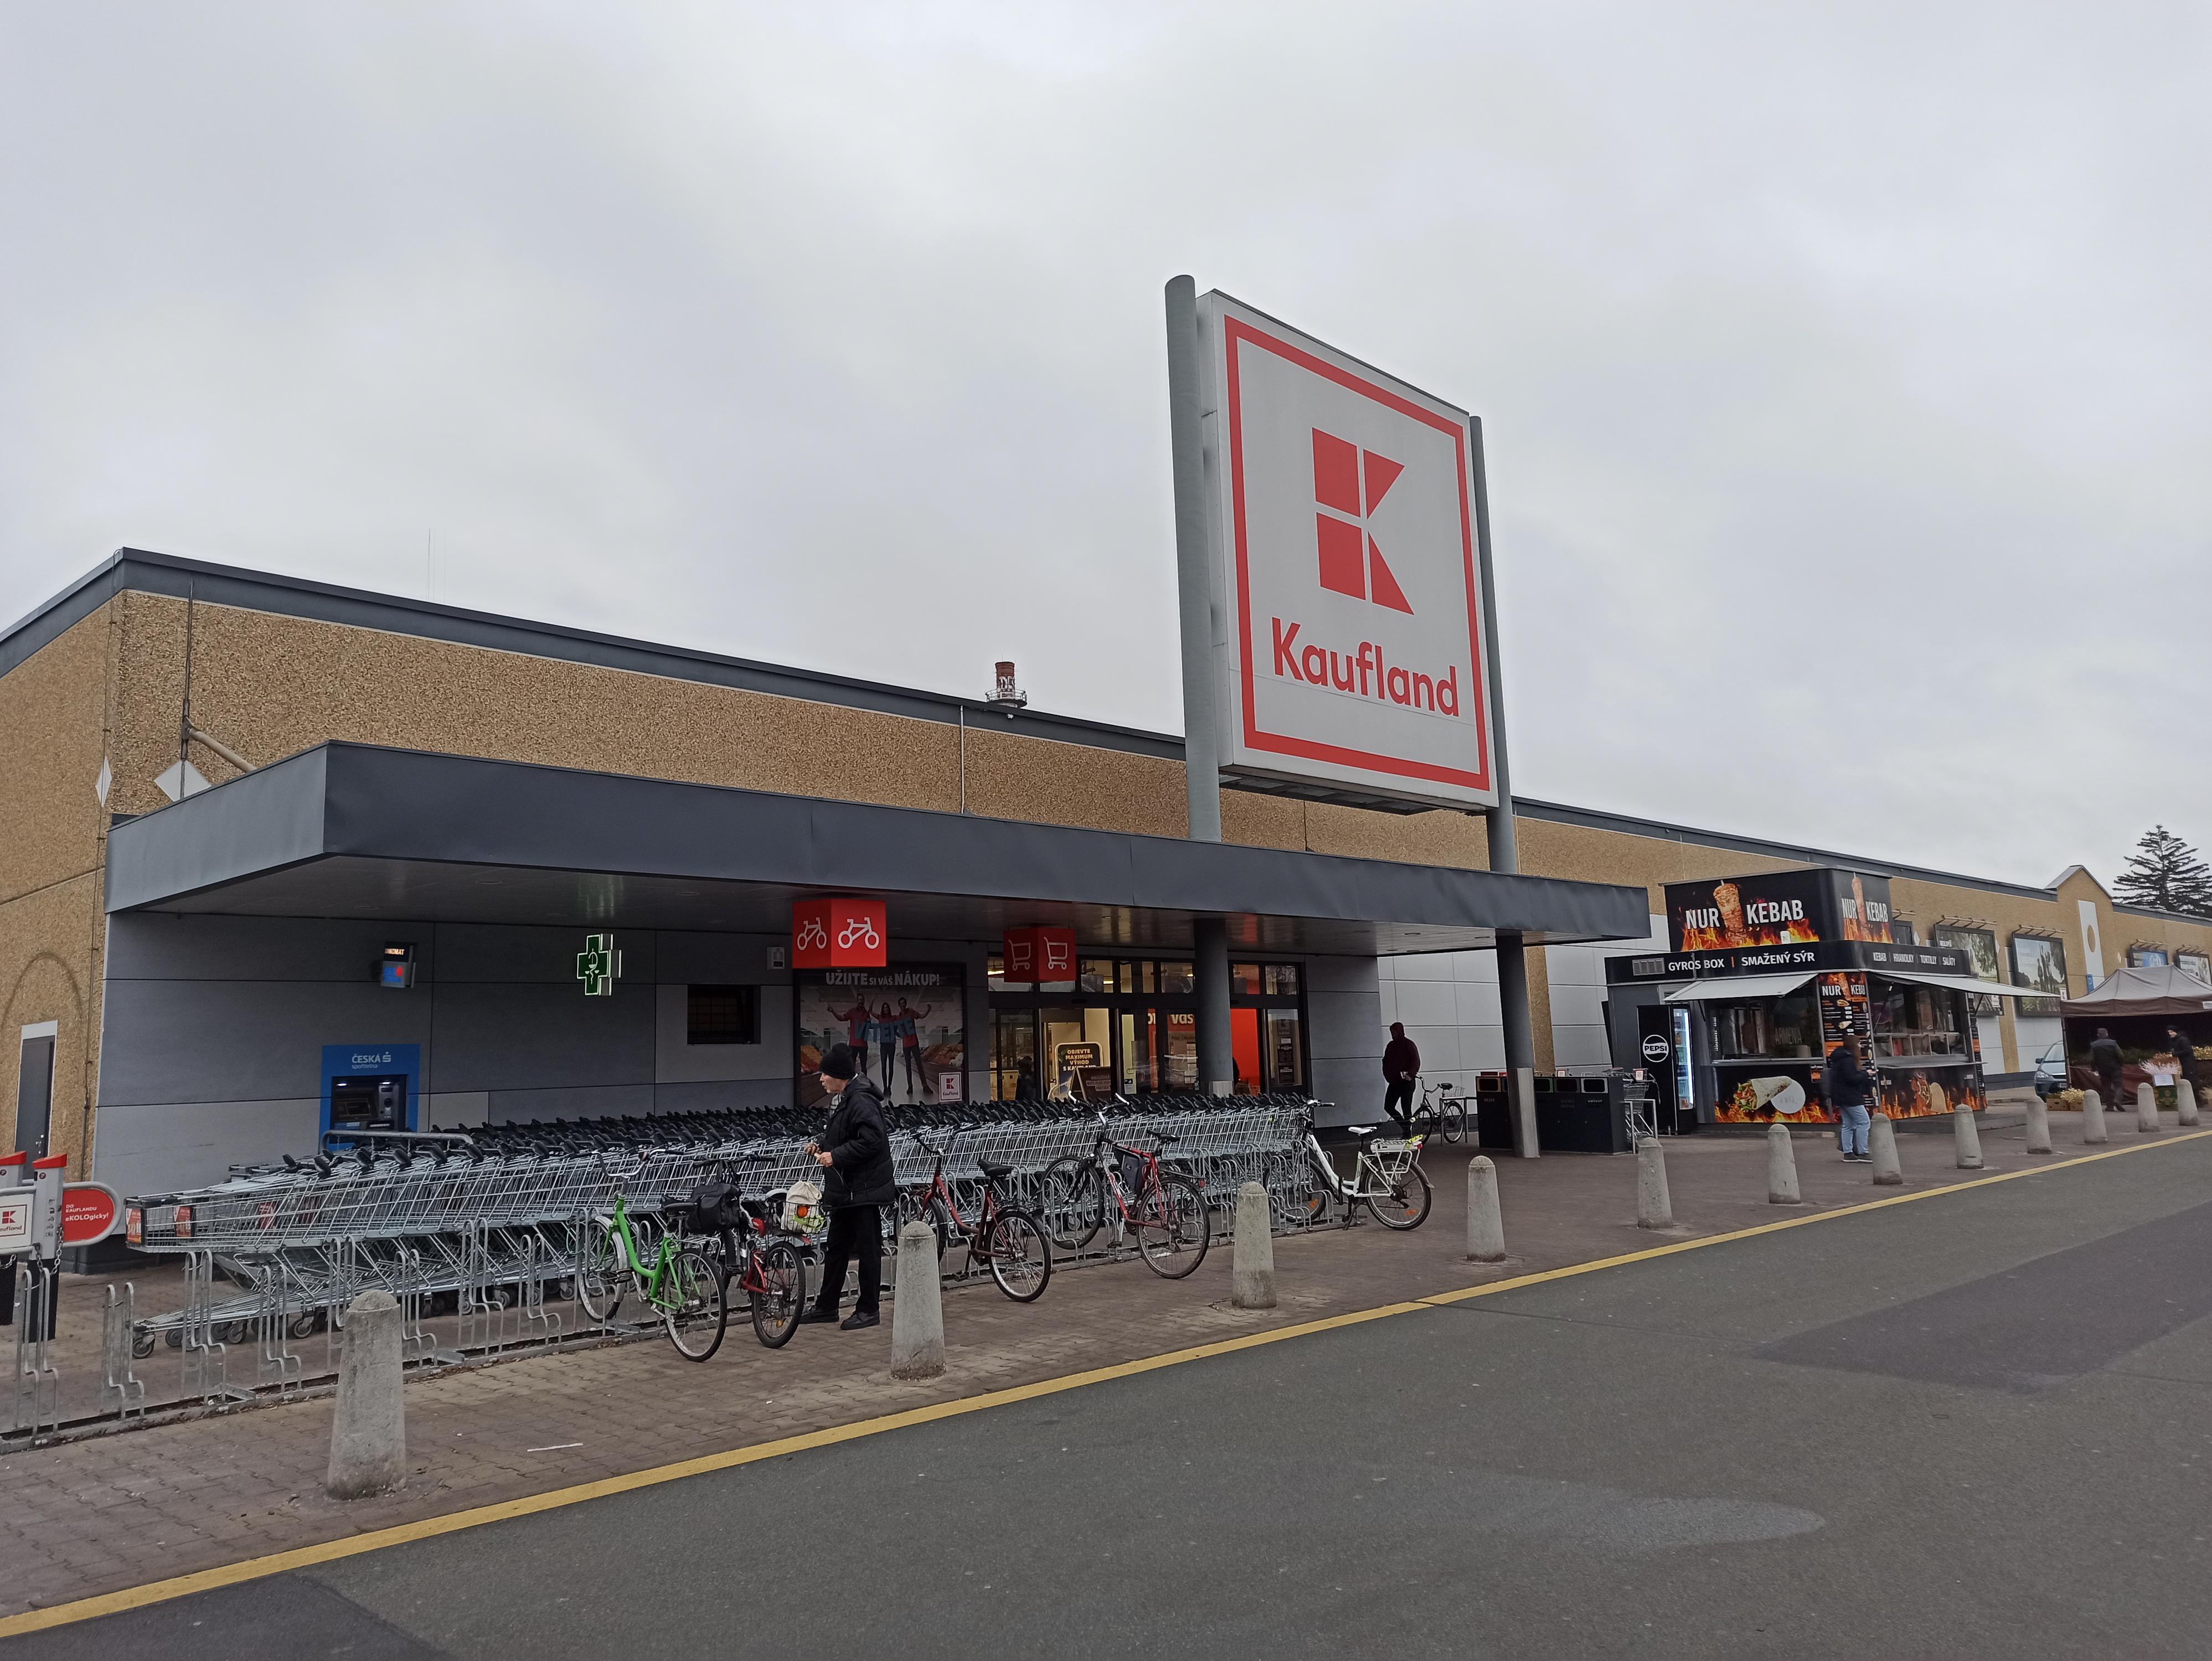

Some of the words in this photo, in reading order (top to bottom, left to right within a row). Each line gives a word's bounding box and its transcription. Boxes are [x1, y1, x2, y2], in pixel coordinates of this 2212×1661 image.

[1271, 616, 1460, 717] Kaufland
[1685, 908, 1720, 930] NUR
[1746, 900, 1804, 924] KEBAB
[1841, 898, 1858, 919] NUR
[1866, 901, 1889, 922] KEBAB
[1741, 951, 1791, 966] SMAŽENÝ
[1793, 950, 1816, 962] SÝR
[1873, 952, 1887, 962] KEBAB
[1893, 953, 1914, 963] HRANOLKY
[1919, 955, 1937, 964] TORTILLY
[1942, 955, 1956, 966] SALÁTY
[1668, 960, 1701, 971] GYROS
[1704, 958, 1725, 968] BOX
[826, 969, 868, 986] UŽIJTE
[869, 977, 877, 986] SI
[878, 976, 894, 986] VÁŠ
[894, 971, 940, 986] NÁKUP!
[1822, 985, 1842, 996] NUR
[352, 1054, 381, 1063] ČESKÁ
[65, 1212, 109, 1221] eKOLOgicky!
